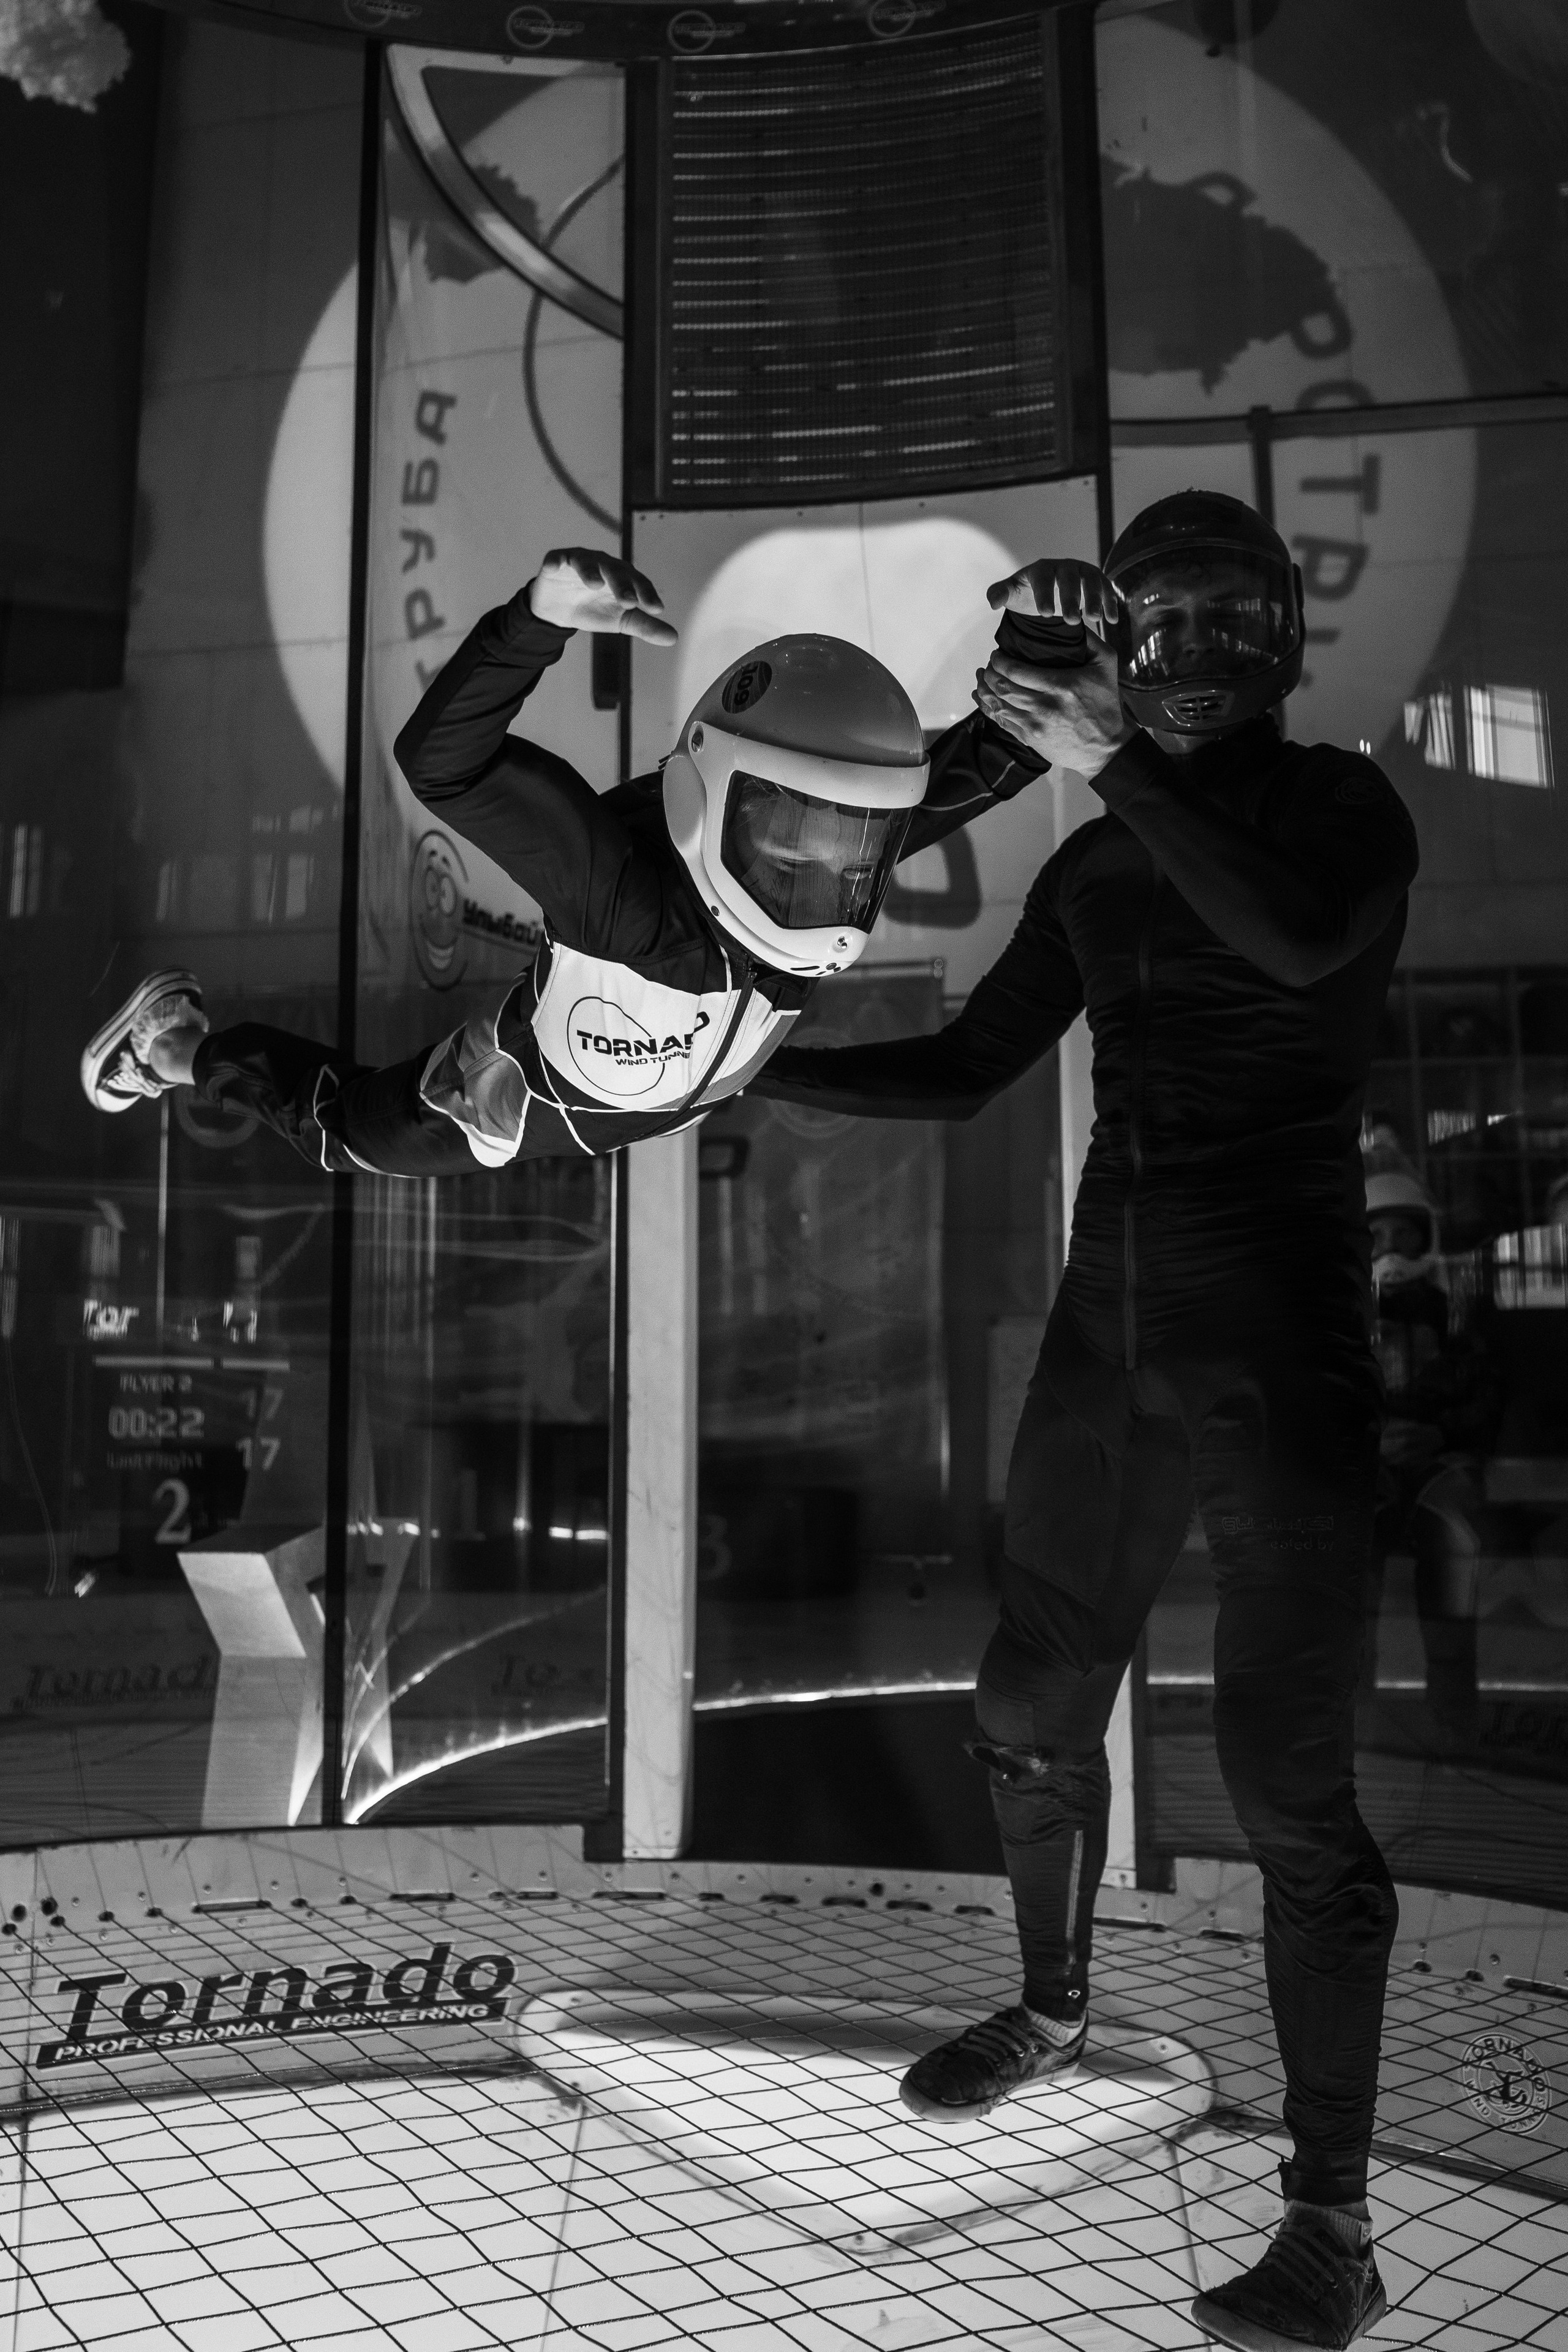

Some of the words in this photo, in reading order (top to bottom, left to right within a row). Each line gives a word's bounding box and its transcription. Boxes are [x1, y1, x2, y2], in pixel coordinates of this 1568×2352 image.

[615, 1058, 648, 1066] WIND
[107, 1406, 206, 1439] 00:22
[235, 1436, 282, 1471] 17
[152, 1477, 192, 1545] 2
[55, 1941, 516, 2041] Tornado
[291, 2004, 489, 2030] ENGINEERING
[54, 2020, 282, 2060] PROFESSIONAL
